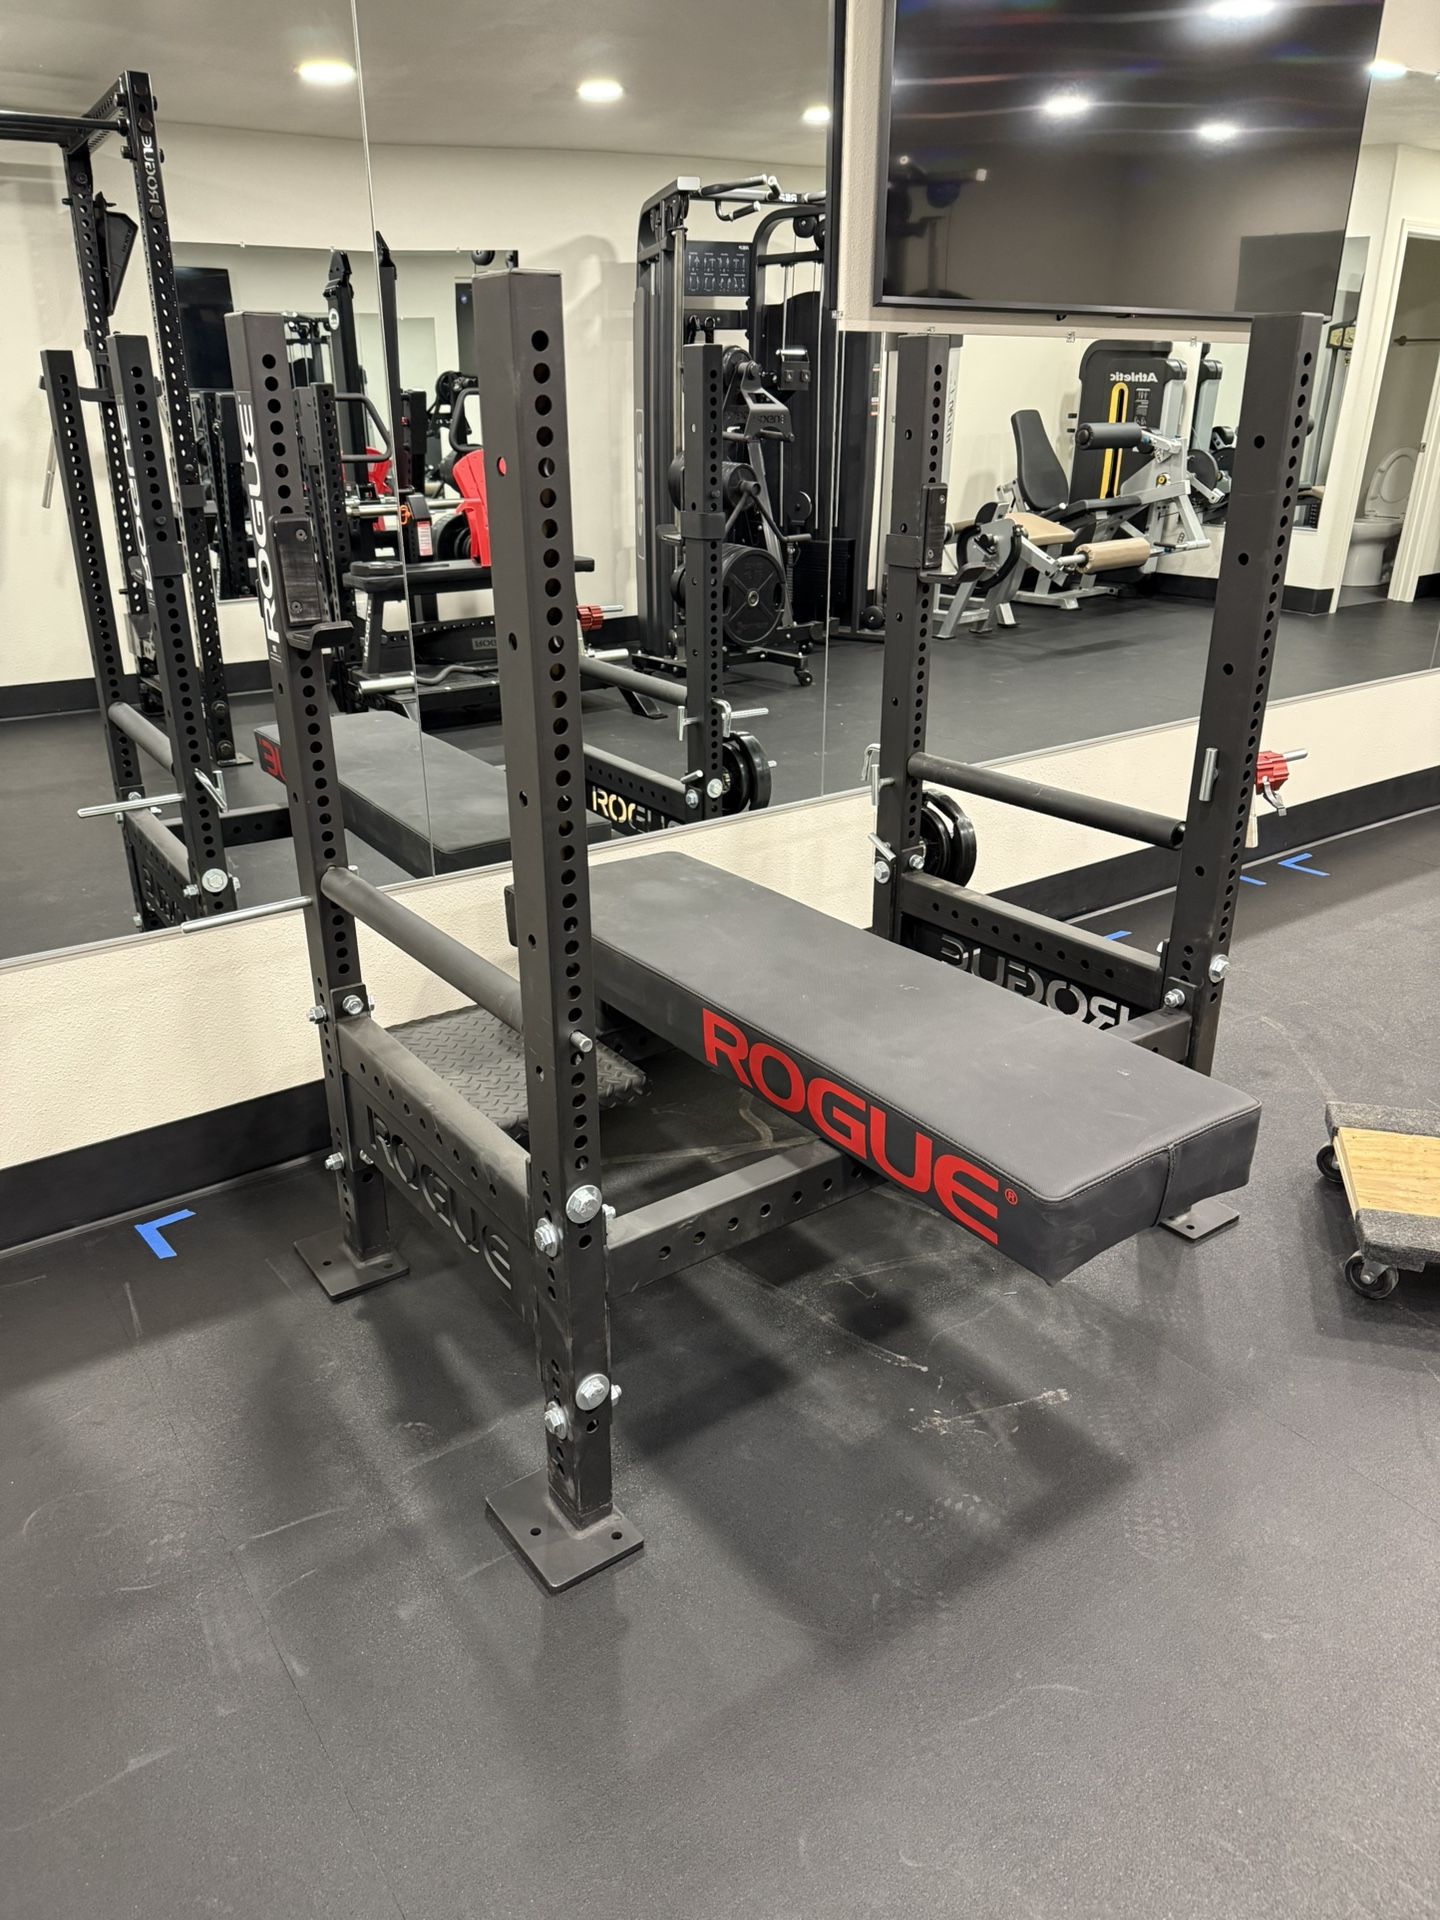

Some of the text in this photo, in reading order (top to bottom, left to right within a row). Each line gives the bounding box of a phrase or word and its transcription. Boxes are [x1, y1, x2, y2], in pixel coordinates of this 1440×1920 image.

[237, 403, 281, 644] ROGUE
[366, 1104, 512, 1290] ROGUE
[702, 1007, 999, 1245] ROGUE
